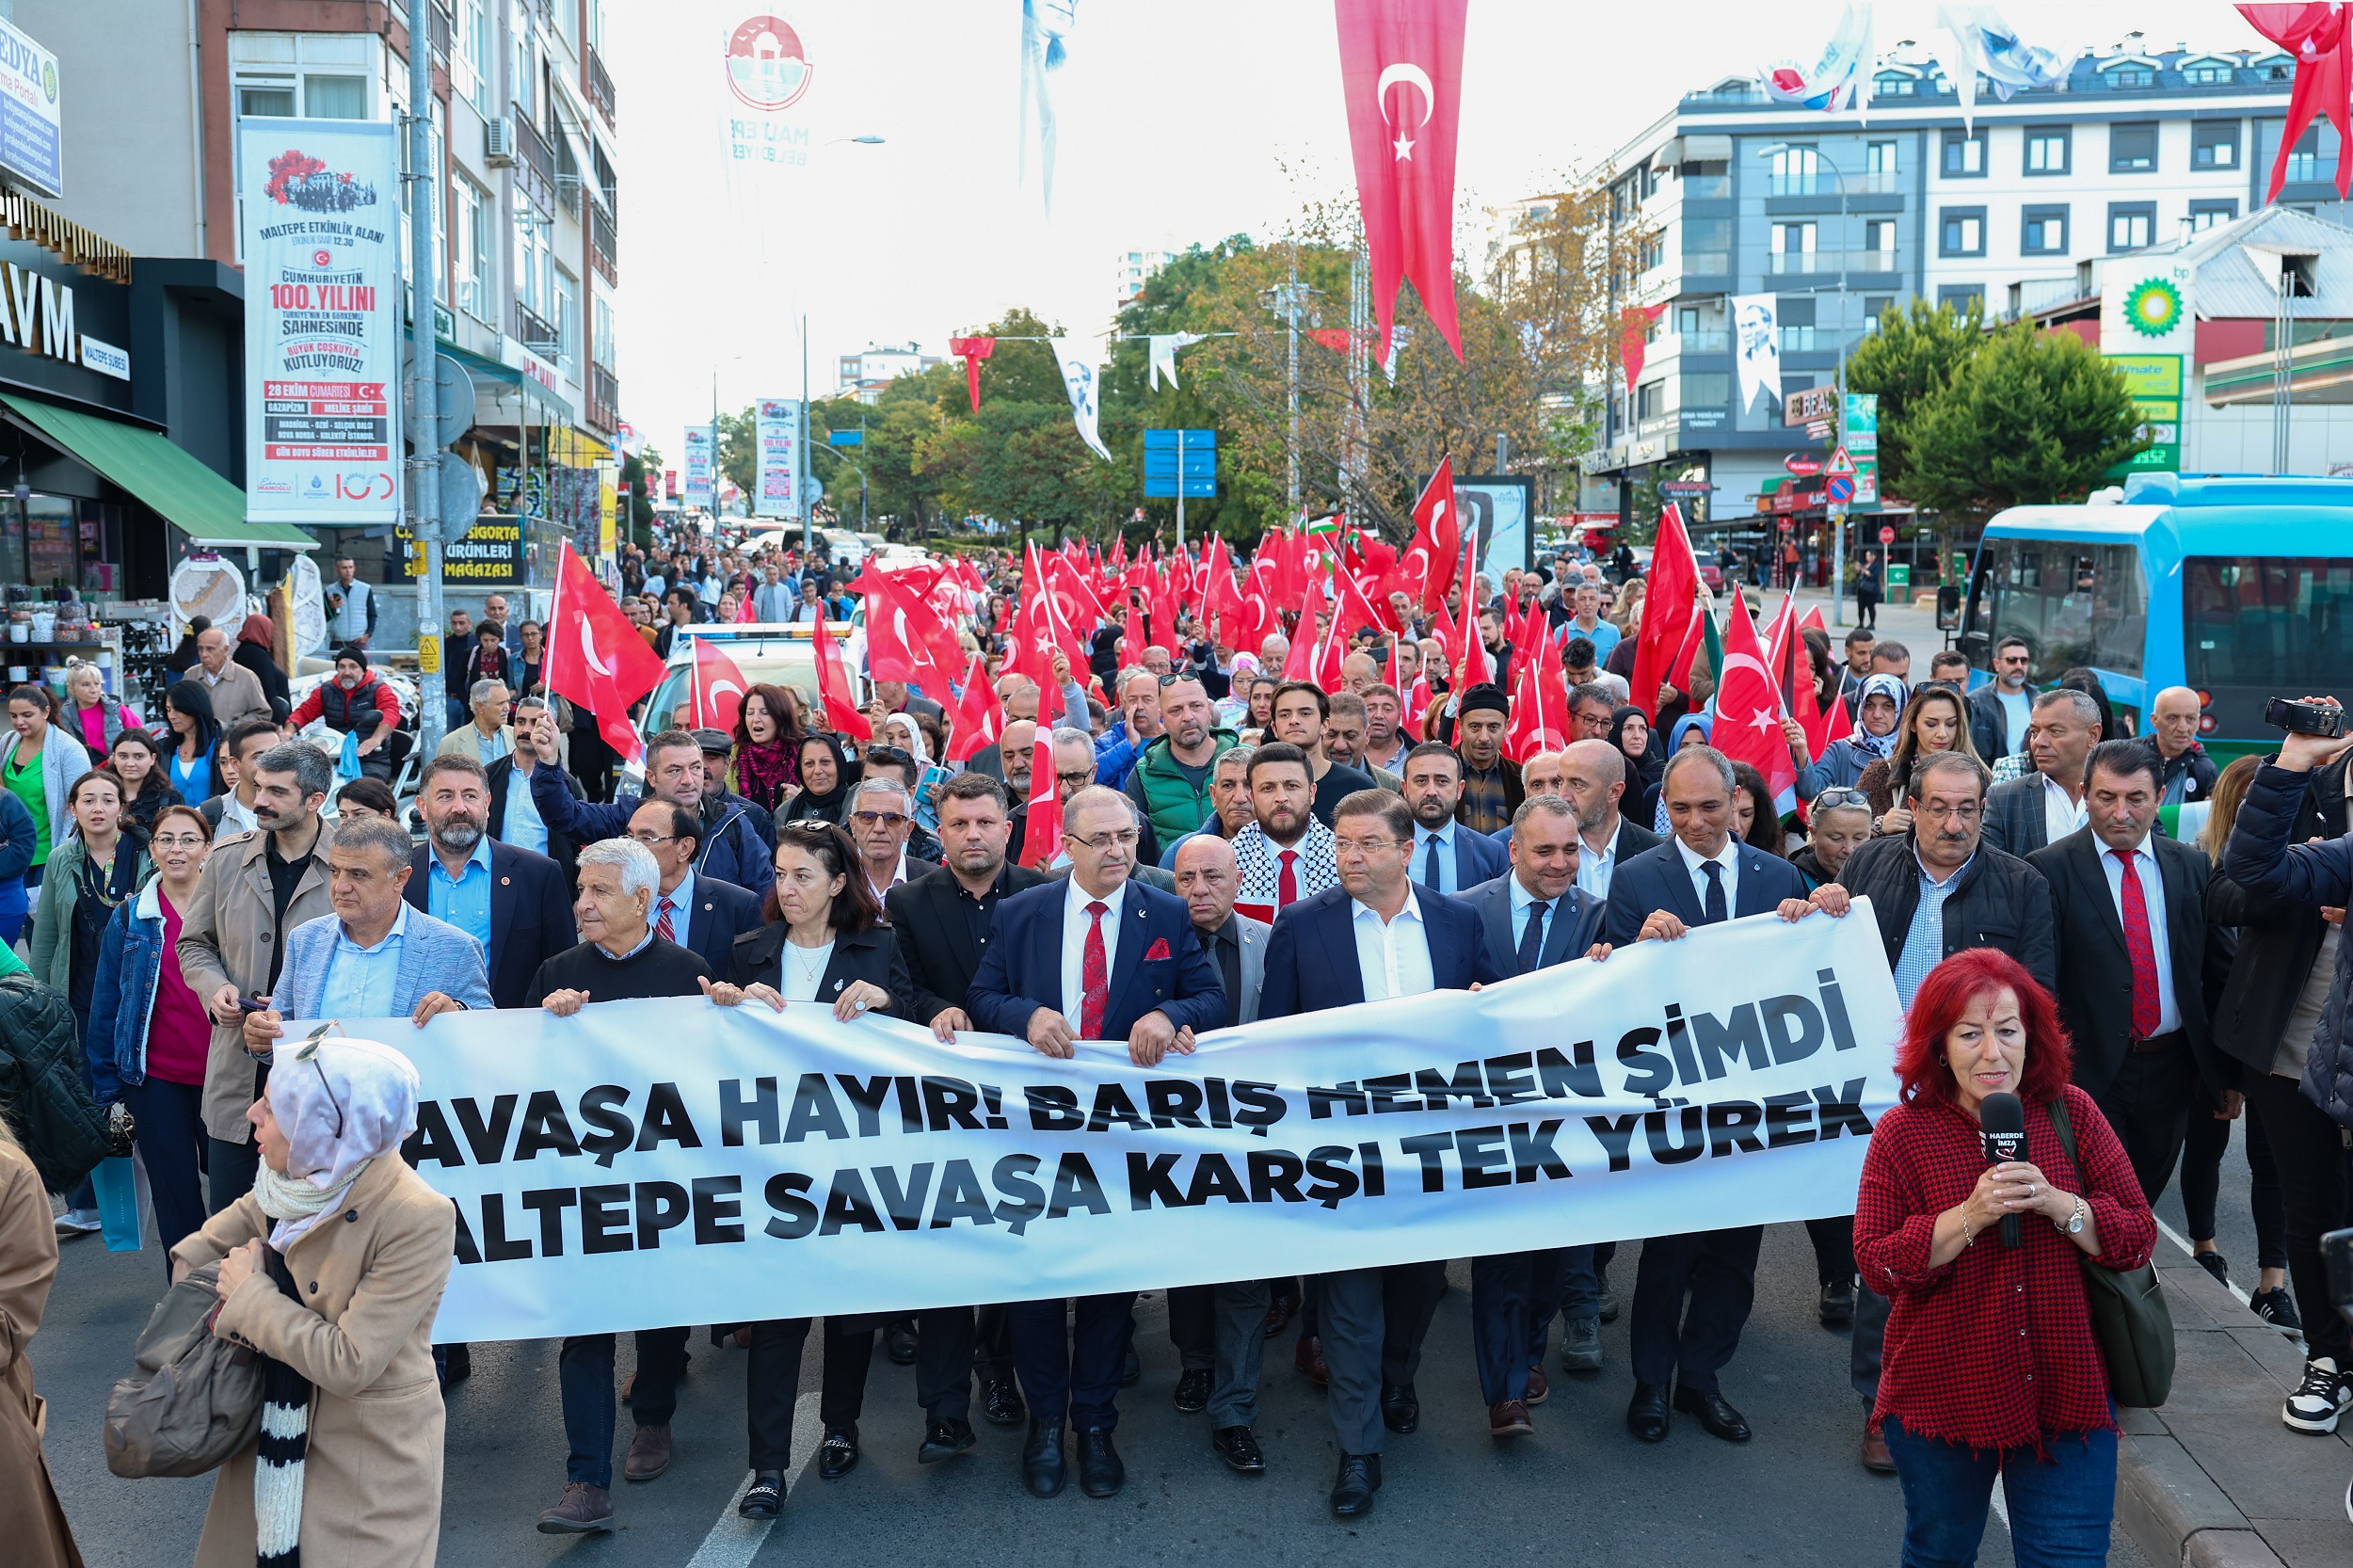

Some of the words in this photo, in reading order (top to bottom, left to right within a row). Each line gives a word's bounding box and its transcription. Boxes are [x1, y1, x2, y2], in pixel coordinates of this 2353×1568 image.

[259, 221, 306, 241] MALTEPE
[309, 219, 353, 236] ETKİNLİK
[355, 226, 385, 245] ALANI
[333, 236, 354, 248] 12.30
[2173, 265, 2190, 280] bp
[270, 283, 376, 312] 100.YILINI
[85, 344, 108, 366] MALTEPE
[287, 343, 314, 356] BÜYÜK
[317, 343, 360, 358] COŞKUYLA
[282, 354, 364, 374] KUTLUYORUZ!
[268, 384, 282, 396] 28
[283, 382, 308, 397] EKİM
[310, 383, 351, 398] CUMARTESİ
[267, 402, 305, 413] GAZAPİZM
[324, 403, 351, 413] MELİKE
[352, 403, 374, 416] ŞAHİN
[276, 446, 291, 456] GÜN
[292, 447, 311, 456] BOYU
[312, 446, 334, 457] SÜREN
[336, 446, 377, 458] ETKİNLİKLER
[468, 522, 520, 541] SİGORTA
[446, 540, 512, 560] ÜRÜNLERİ
[444, 559, 512, 579] MAĞAZASI
[399, 1082, 703, 1169] AVAŞA
[719, 1073, 1010, 1147] HAYIR!
[1024, 1077, 1288, 1138] BARIŞ
[1306, 1040, 1607, 1120] HEMEN
[1616, 968, 1857, 1098] ŞİMDİ
[764, 1152, 1112, 1240] SAVAŞA
[1126, 1142, 1385, 1212] KARŞI
[1400, 1119, 1574, 1193] TEK
[1582, 1077, 1874, 1173] YÜREK
